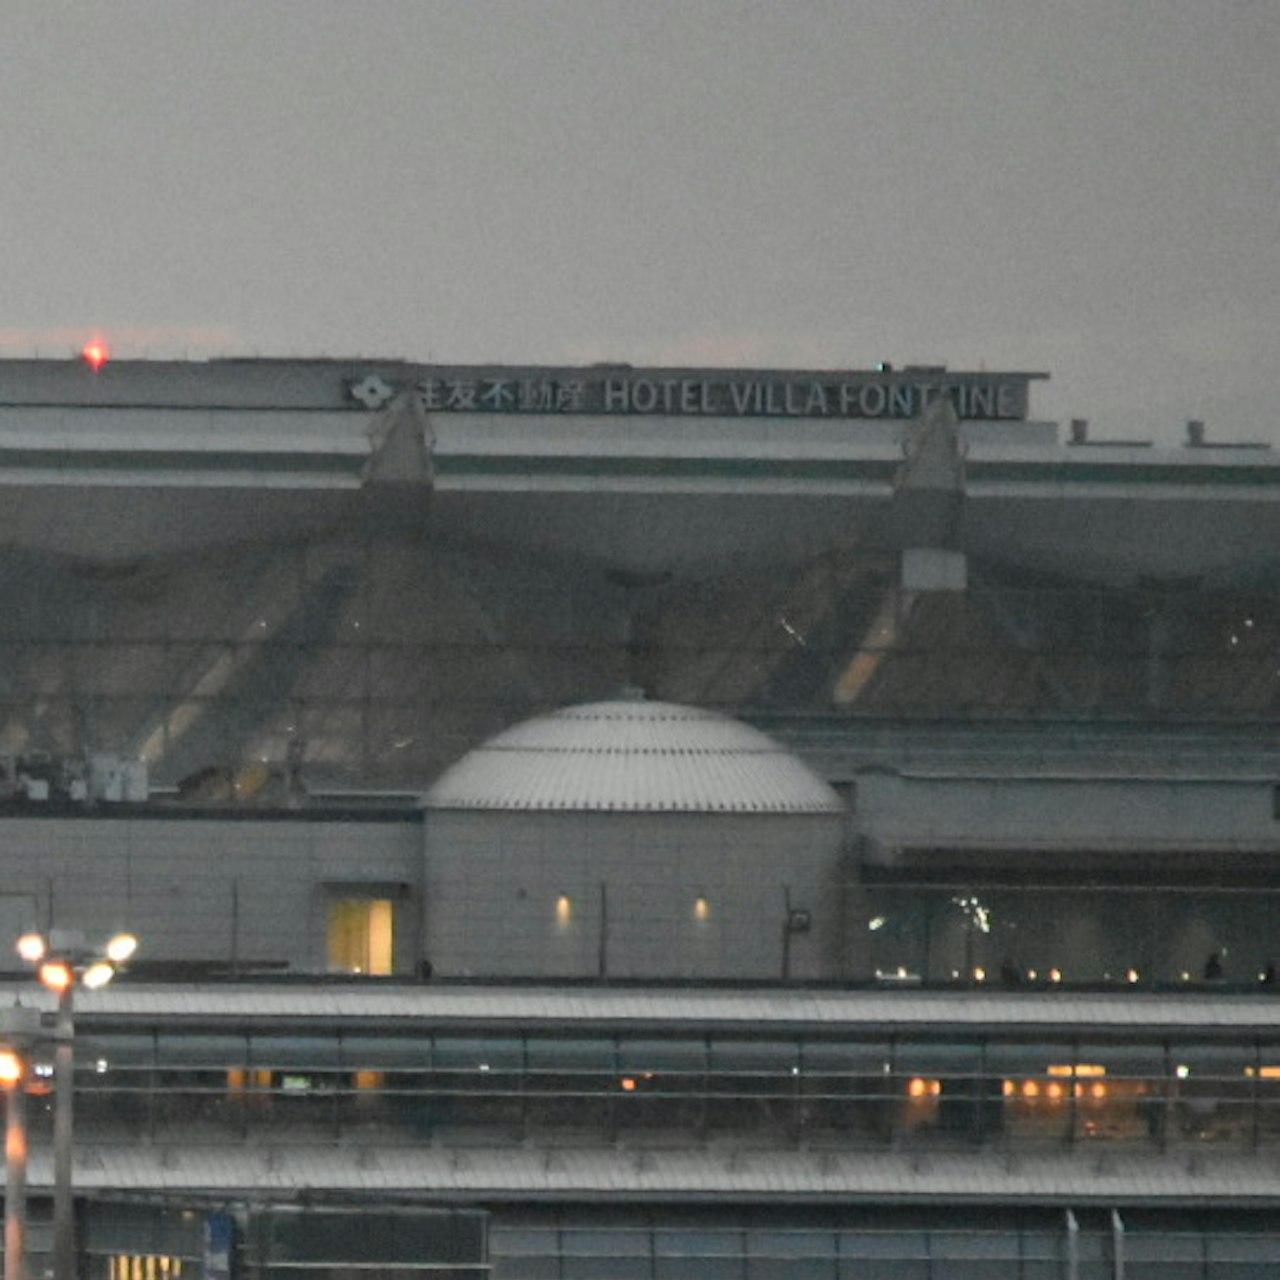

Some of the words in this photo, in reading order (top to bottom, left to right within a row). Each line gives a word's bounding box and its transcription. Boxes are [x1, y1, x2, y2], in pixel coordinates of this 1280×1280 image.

[604, 378, 716, 413] HOTEL
[728, 380, 828, 415] VILLA
[841, 382, 1014, 417] FONTINE
